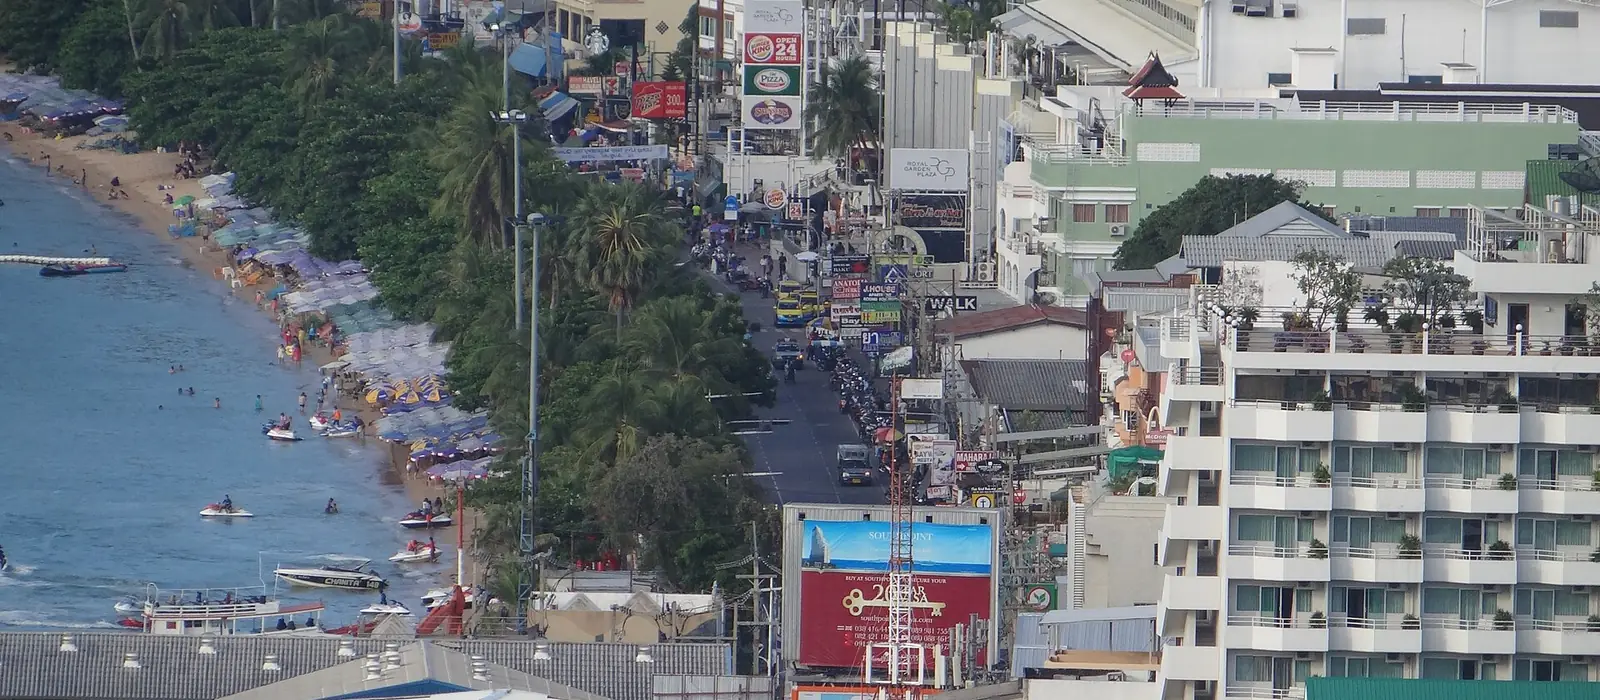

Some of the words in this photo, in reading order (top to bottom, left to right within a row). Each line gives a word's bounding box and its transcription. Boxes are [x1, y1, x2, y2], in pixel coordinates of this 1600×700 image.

[751, 45, 770, 54] KING
[775, 44, 797, 56] 24
[761, 75, 784, 83] PIZZA
[841, 317, 860, 325] Bay
[324, 577, 360, 587] CHANITA
